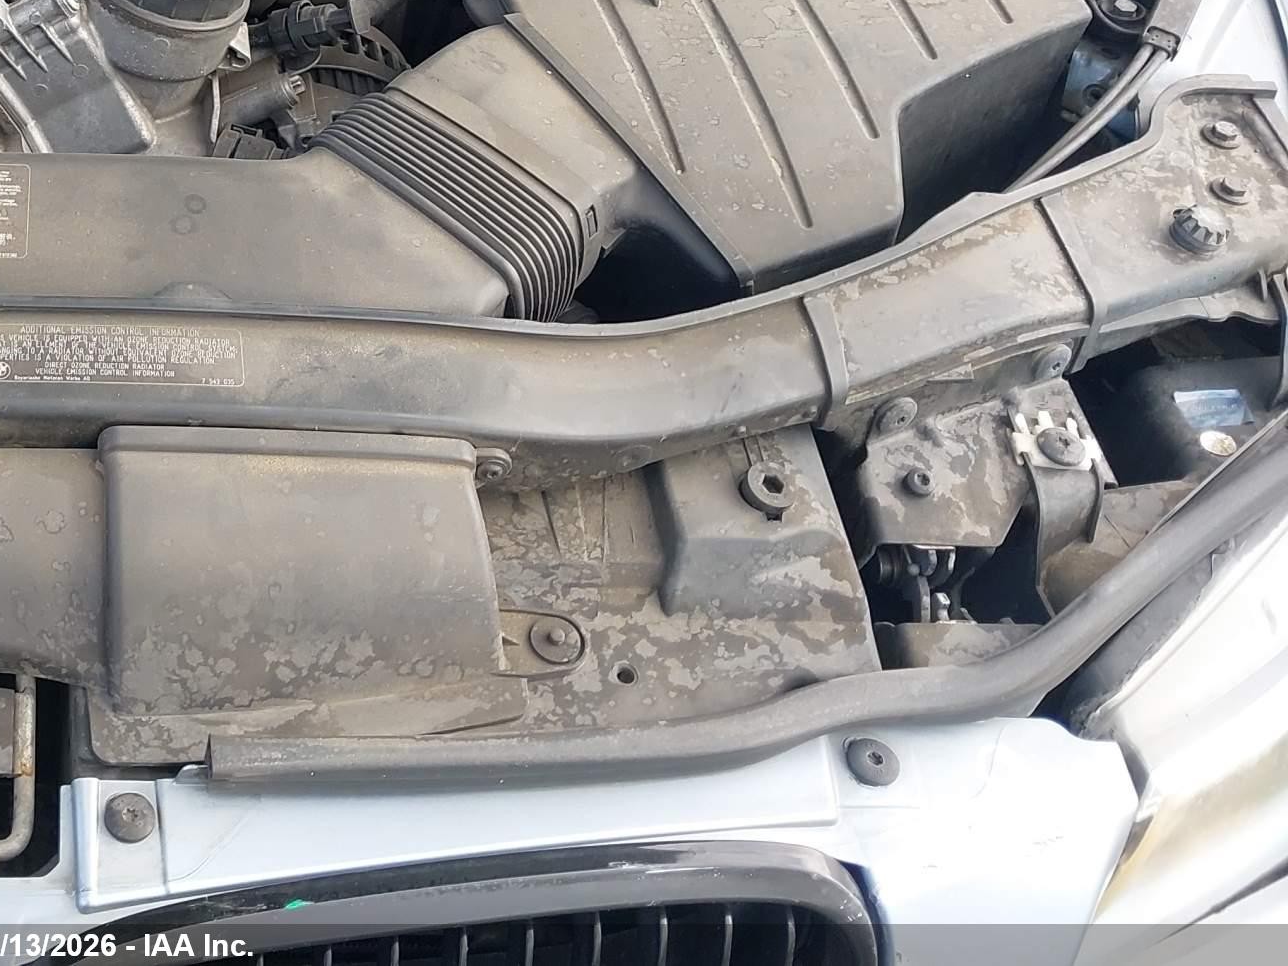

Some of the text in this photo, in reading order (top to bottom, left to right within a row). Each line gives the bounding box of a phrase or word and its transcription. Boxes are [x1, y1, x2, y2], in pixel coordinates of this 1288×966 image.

[21, 326, 65, 334] ADDITIONAL
[111, 326, 144, 335] CONTROL
[150, 328, 200, 337] INFORMATION
[198, 351, 236, 359] REDUCTION
